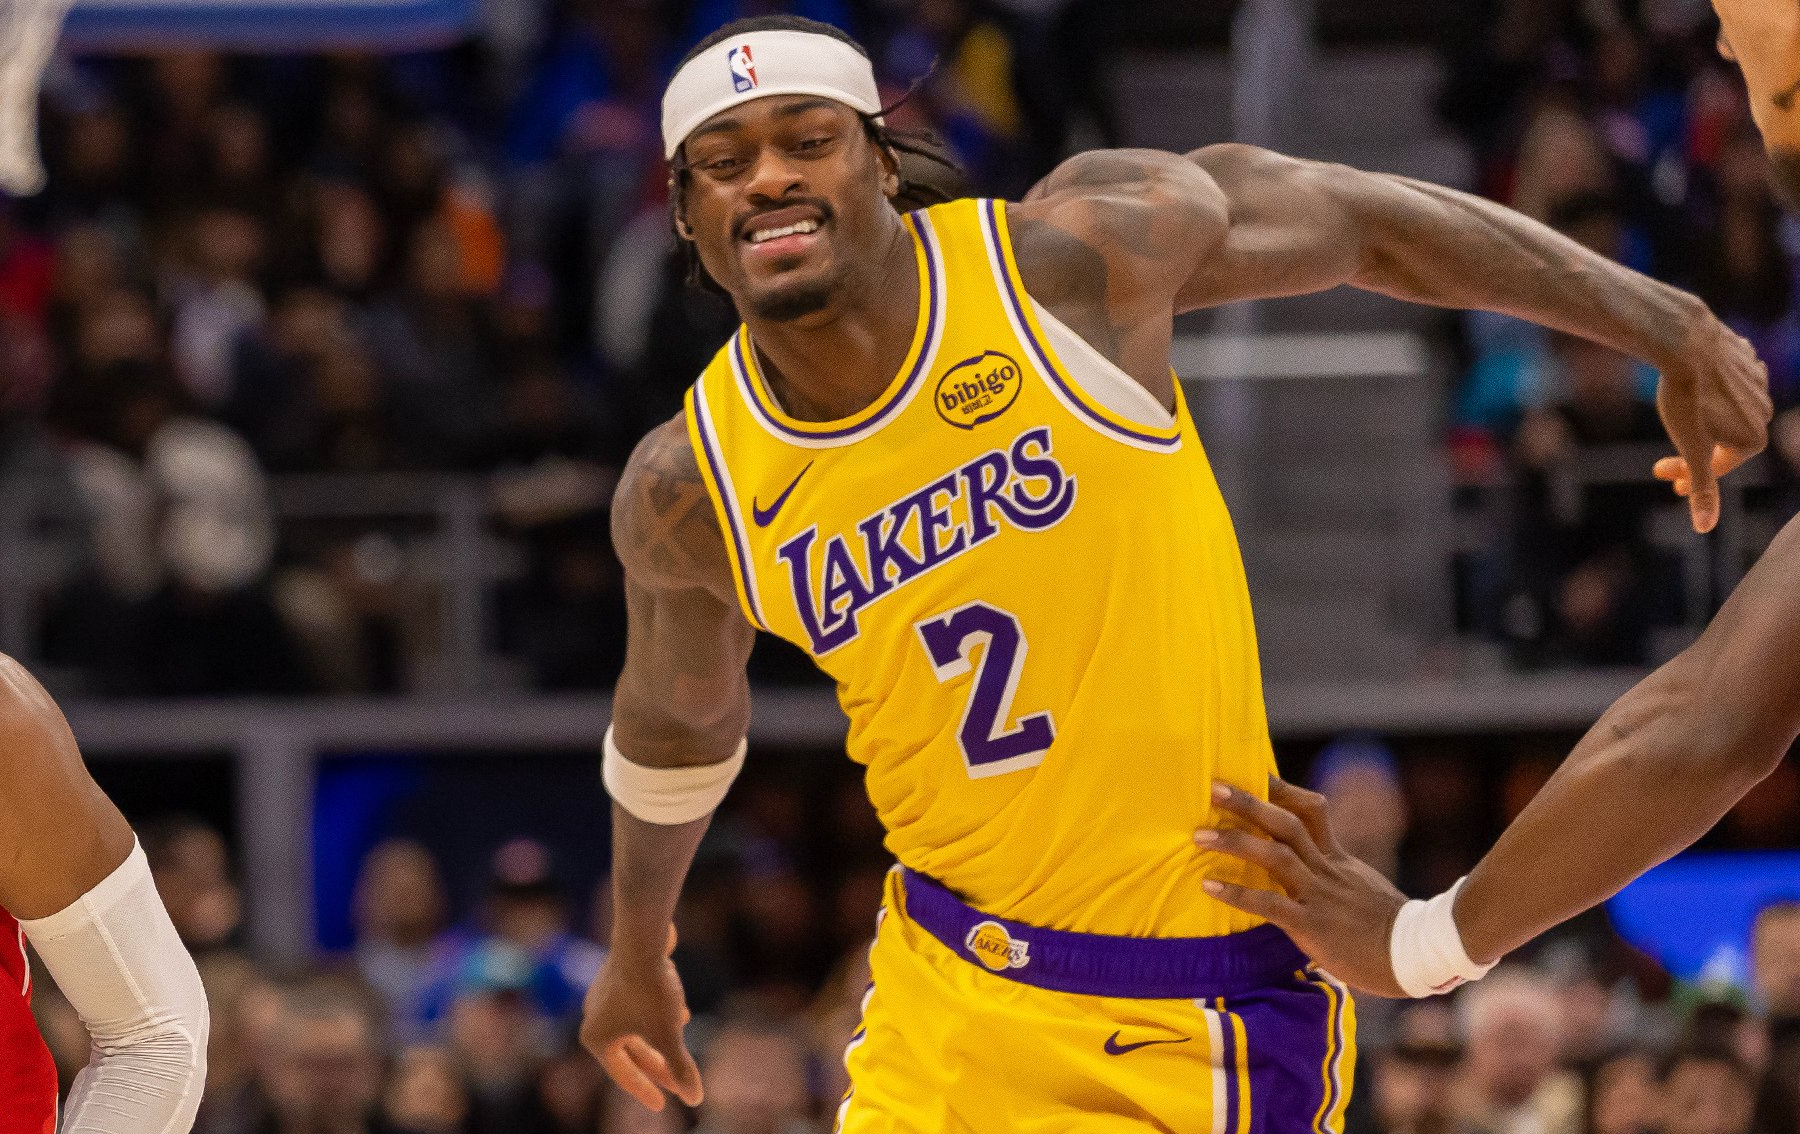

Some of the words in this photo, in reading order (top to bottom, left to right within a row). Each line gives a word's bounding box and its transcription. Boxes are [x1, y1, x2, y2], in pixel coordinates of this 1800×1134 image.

[941, 366, 1015, 410] bibigo
[776, 425, 1078, 657] LAKERS
[913, 600, 1058, 780] 2
